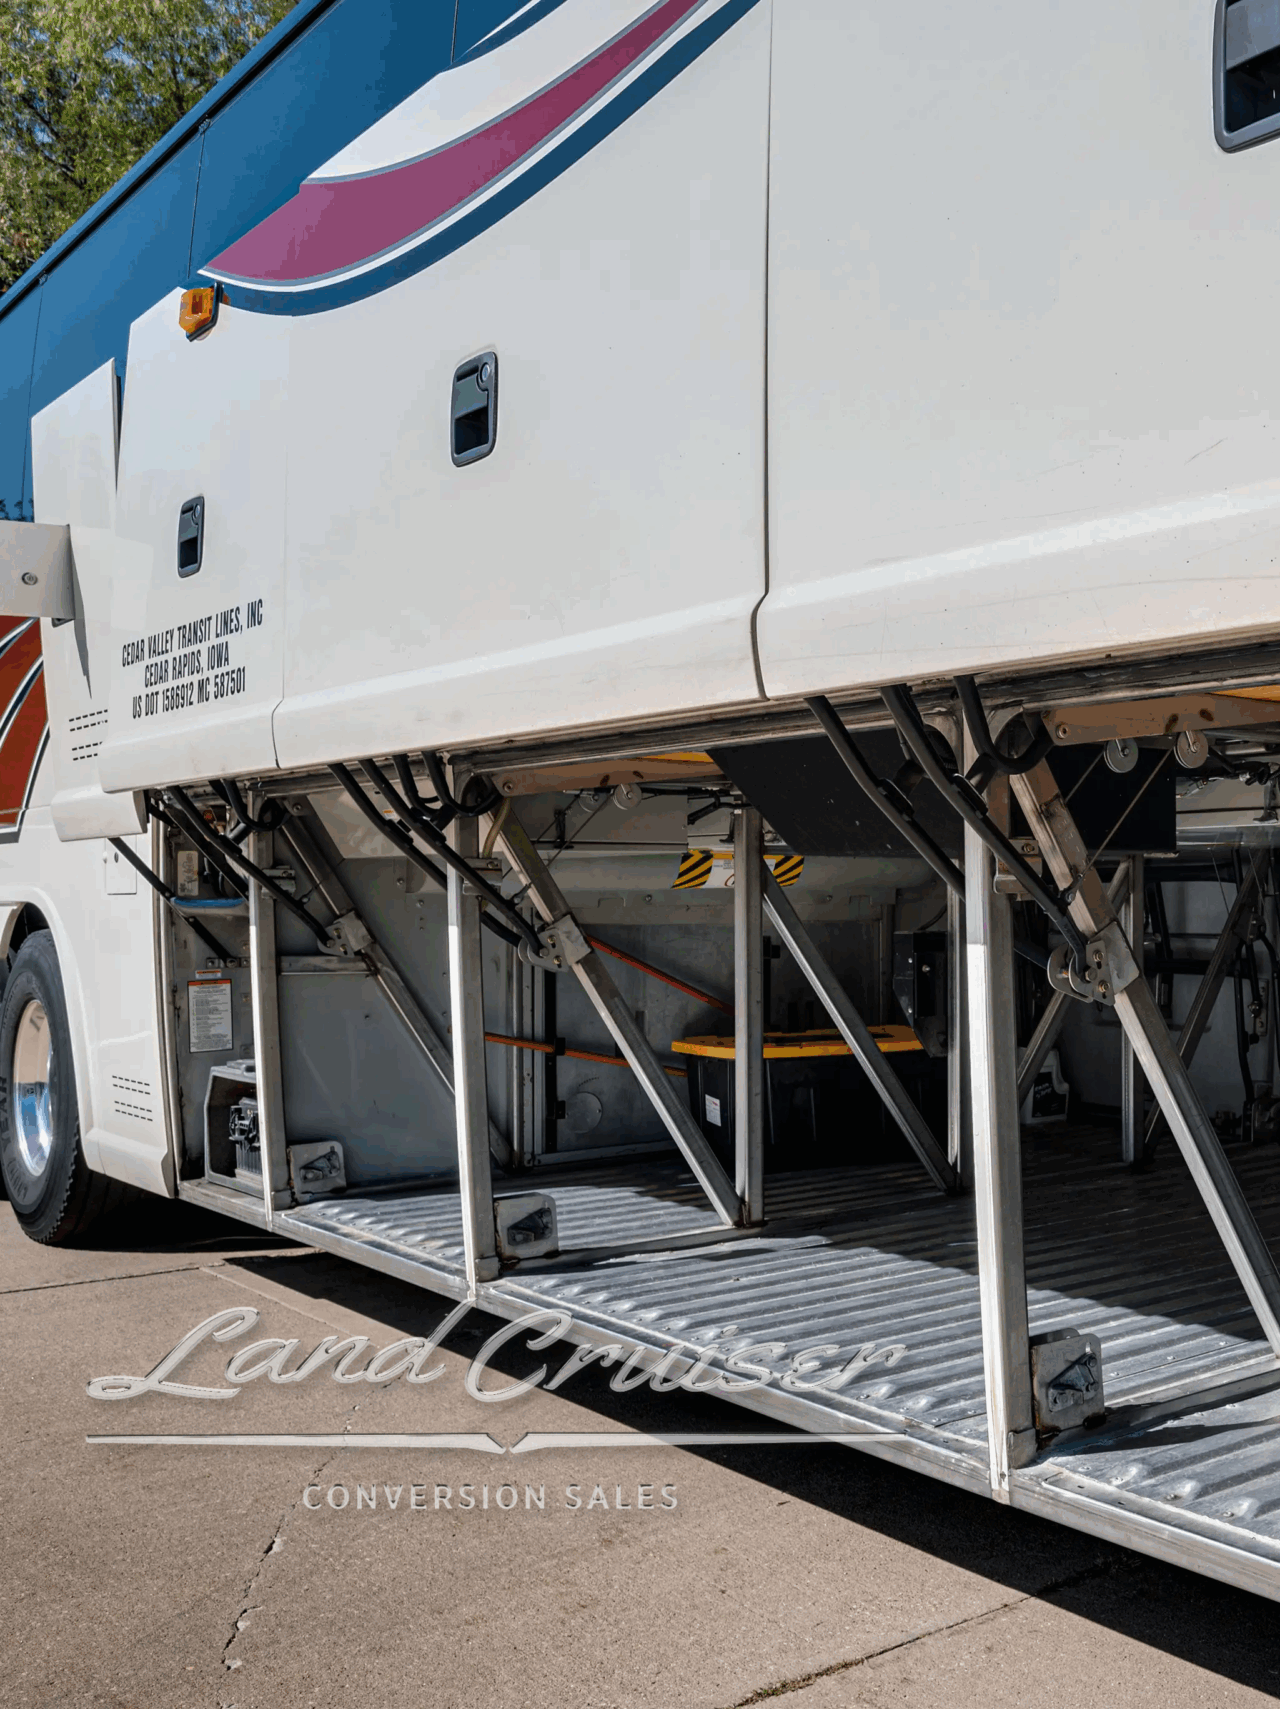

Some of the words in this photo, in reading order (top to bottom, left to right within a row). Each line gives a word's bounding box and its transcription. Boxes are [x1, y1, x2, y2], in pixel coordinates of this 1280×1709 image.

[122, 638, 145, 667] CEDAR
[148, 628, 174, 659] VALLEY
[177, 615, 212, 650] TRANSIT
[215, 606, 243, 639] LINES,
[246, 598, 263, 628] INC
[144, 659, 169, 688] CEDAR
[172, 649, 204, 681] RAPIDS,
[207, 641, 230, 671] IOWA
[132, 694, 142, 719] US
[145, 690, 160, 717] DOT
[162, 681, 194, 713] 1586912
[197, 676, 210, 704] MC
[213, 666, 246, 700] 587501
